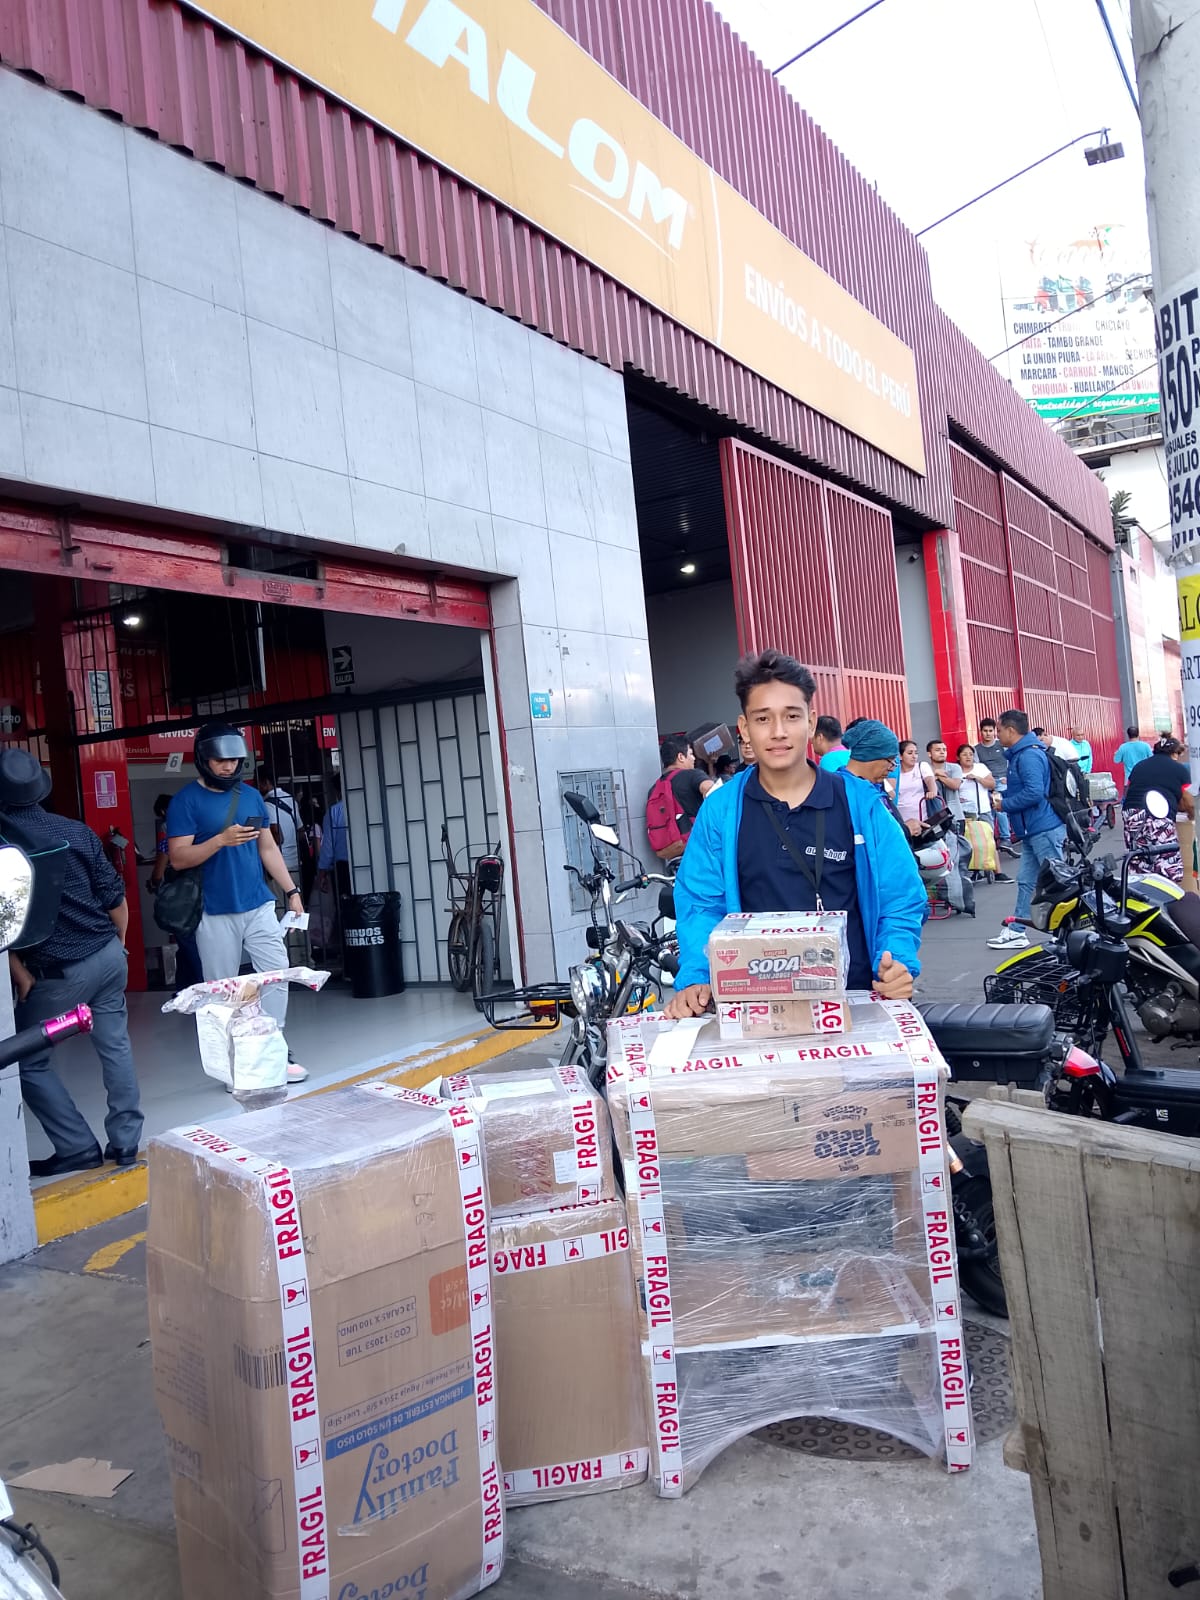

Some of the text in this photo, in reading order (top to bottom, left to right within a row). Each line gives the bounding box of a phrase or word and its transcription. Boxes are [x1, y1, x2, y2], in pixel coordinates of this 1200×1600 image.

[745, 262, 911, 417] ENVÍOS A TODO EL PERÚ
[1048, 336, 1104, 348] TAMBO GRANDE
[1157, 288, 1199, 351] BIT
[1020, 368, 1058, 380] MARCARA
[1102, 364, 1134, 376] MANCOS
[1023, 353, 1032, 364] LA
[1033, 352, 1057, 364] UNION
[1058, 351, 1081, 363] PIURA
[1074, 380, 1116, 393] HUALLANCA
[1161, 345, 1193, 436] 50
[1173, 448, 1200, 479] JULIO
[169, 755, 179, 769] 6
[760, 926, 826, 935] FRAGIL
[748, 955, 801, 976] SODA
[798, 1044, 873, 1061] FRAGIL
[183, 1129, 239, 1154] FRAGIL
[573, 1100, 598, 1169] FRAGIL
[917, 1082, 942, 1156] FRAGIL
[634, 1129, 659, 1200] FRAGIL
[266, 1165, 302, 1260] FRAGIL
[463, 1186, 488, 1270] FRAGIL
[925, 1210, 954, 1285] FRAGIL
[646, 1255, 671, 1329] FRAGIL
[359, 1319, 374, 1330] 100
[285, 1326, 316, 1422] FRAGIL
[473, 1324, 494, 1406] FRAGIL
[940, 1338, 966, 1411] FRAGIL
[392, 1413, 404, 1423] DE
[433, 1385, 465, 1405] JERINGA
[655, 1382, 680, 1454] FRAGIL
[336, 1434, 355, 1449] USO
[356, 1423, 379, 1440] SOLO
[380, 1419, 392, 1431] UN
[353, 1442, 460, 1525] Family
[372, 1430, 458, 1484] Doctor
[532, 1458, 605, 1487] FRAGIL
[481, 1461, 502, 1545] FRAGIL
[296, 1485, 327, 1581] FRAGIL
